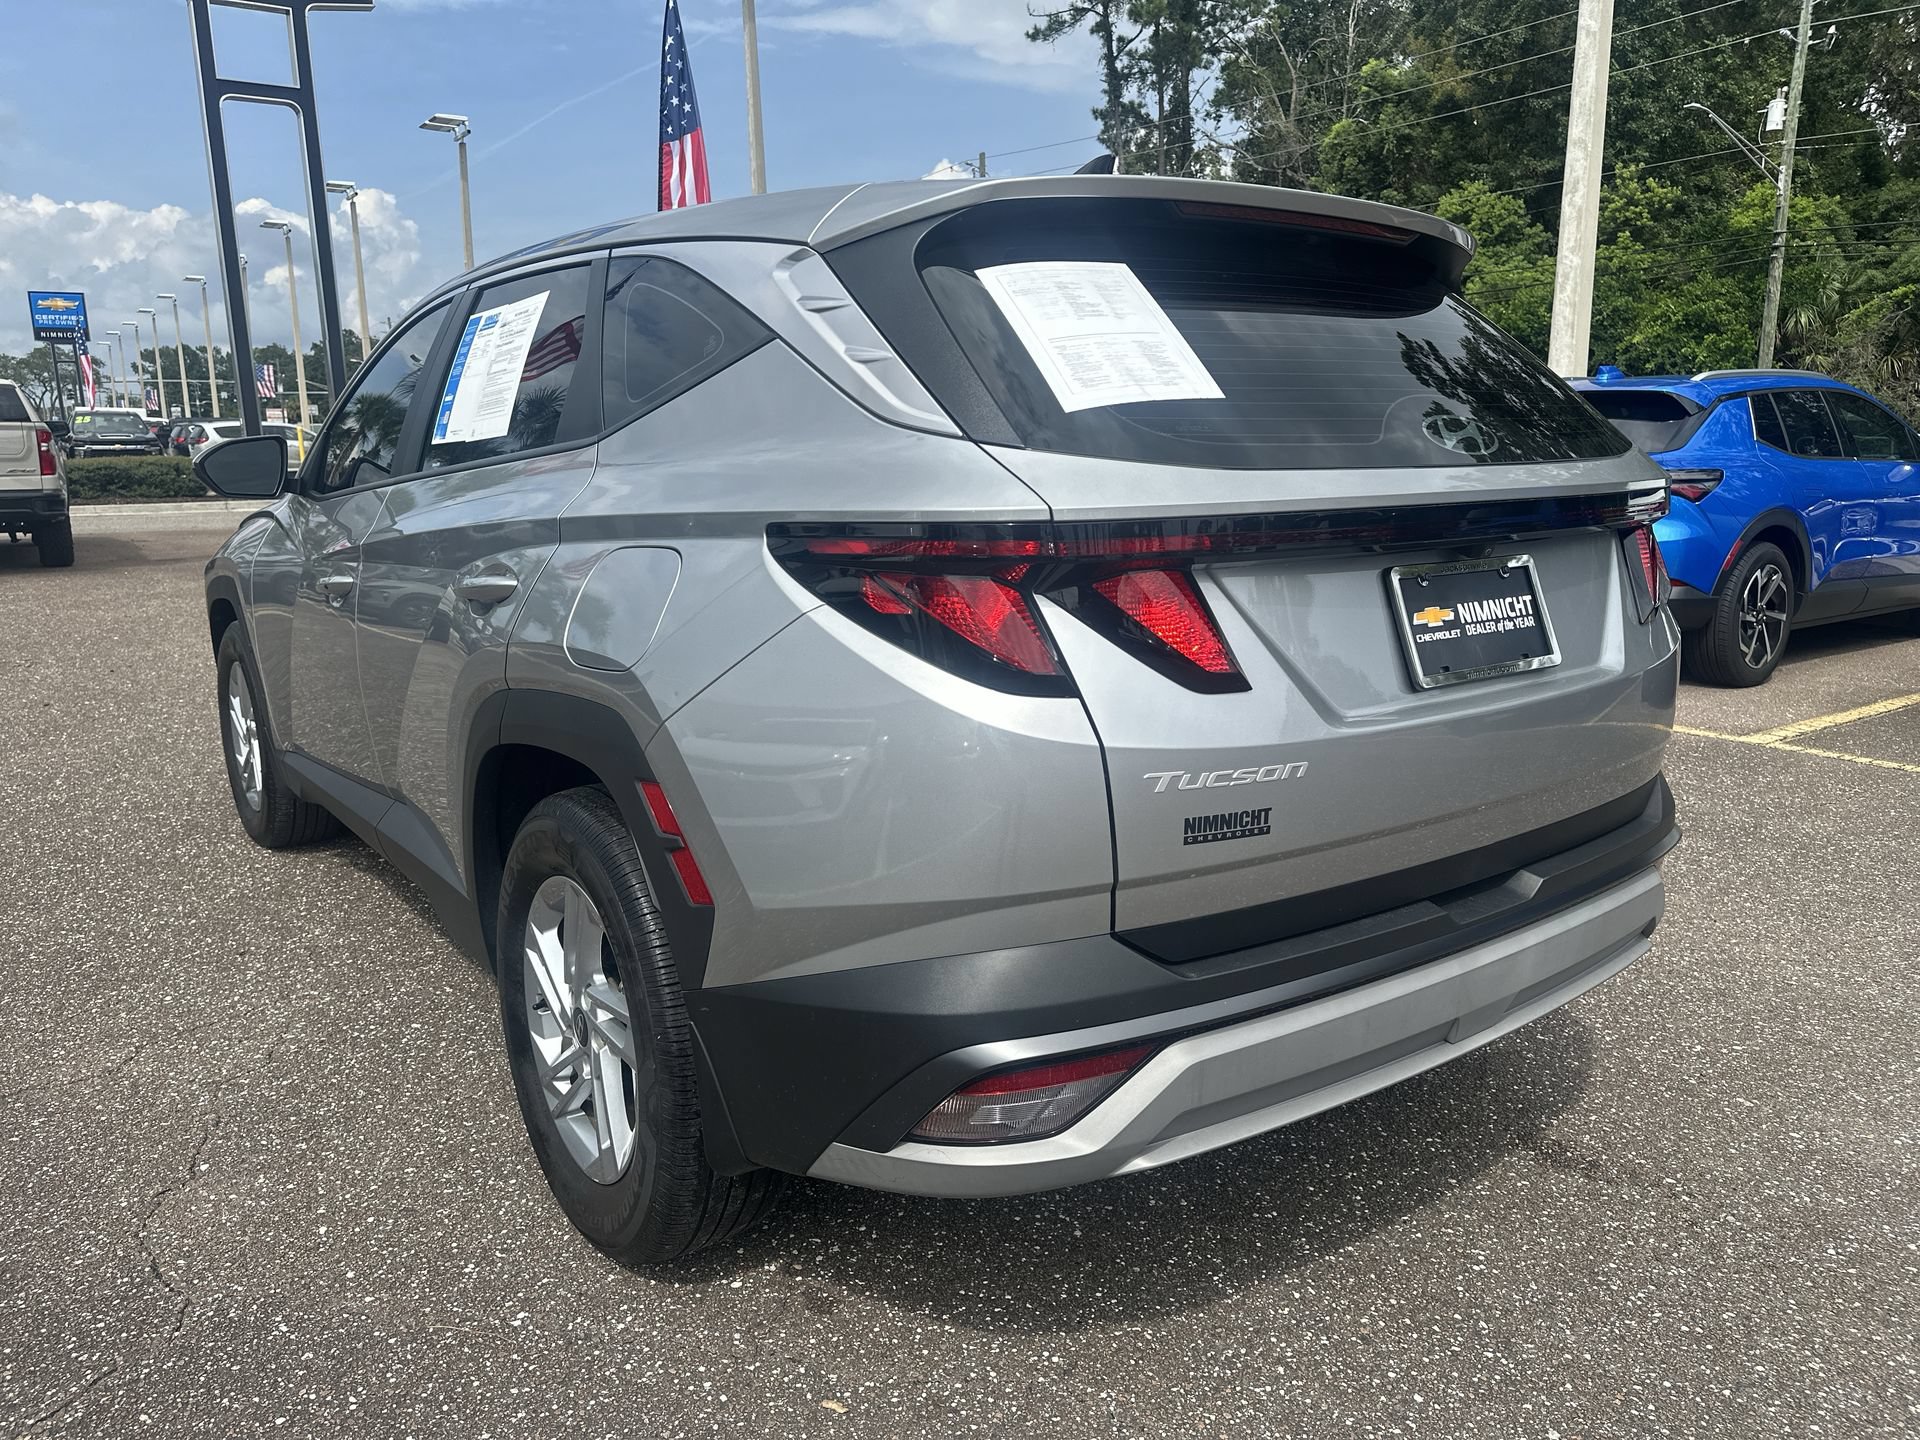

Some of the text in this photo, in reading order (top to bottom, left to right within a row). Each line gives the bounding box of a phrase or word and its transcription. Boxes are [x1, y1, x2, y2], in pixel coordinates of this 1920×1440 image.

[1456, 594, 1534, 624] NIMNICHT
[1415, 628, 1461, 643] CHEVROLET
[1465, 615, 1536, 636] DEALER of the YEAR
[1183, 807, 1273, 836] NIMNICHT
[1186, 826, 1269, 843] CHEVROLET
